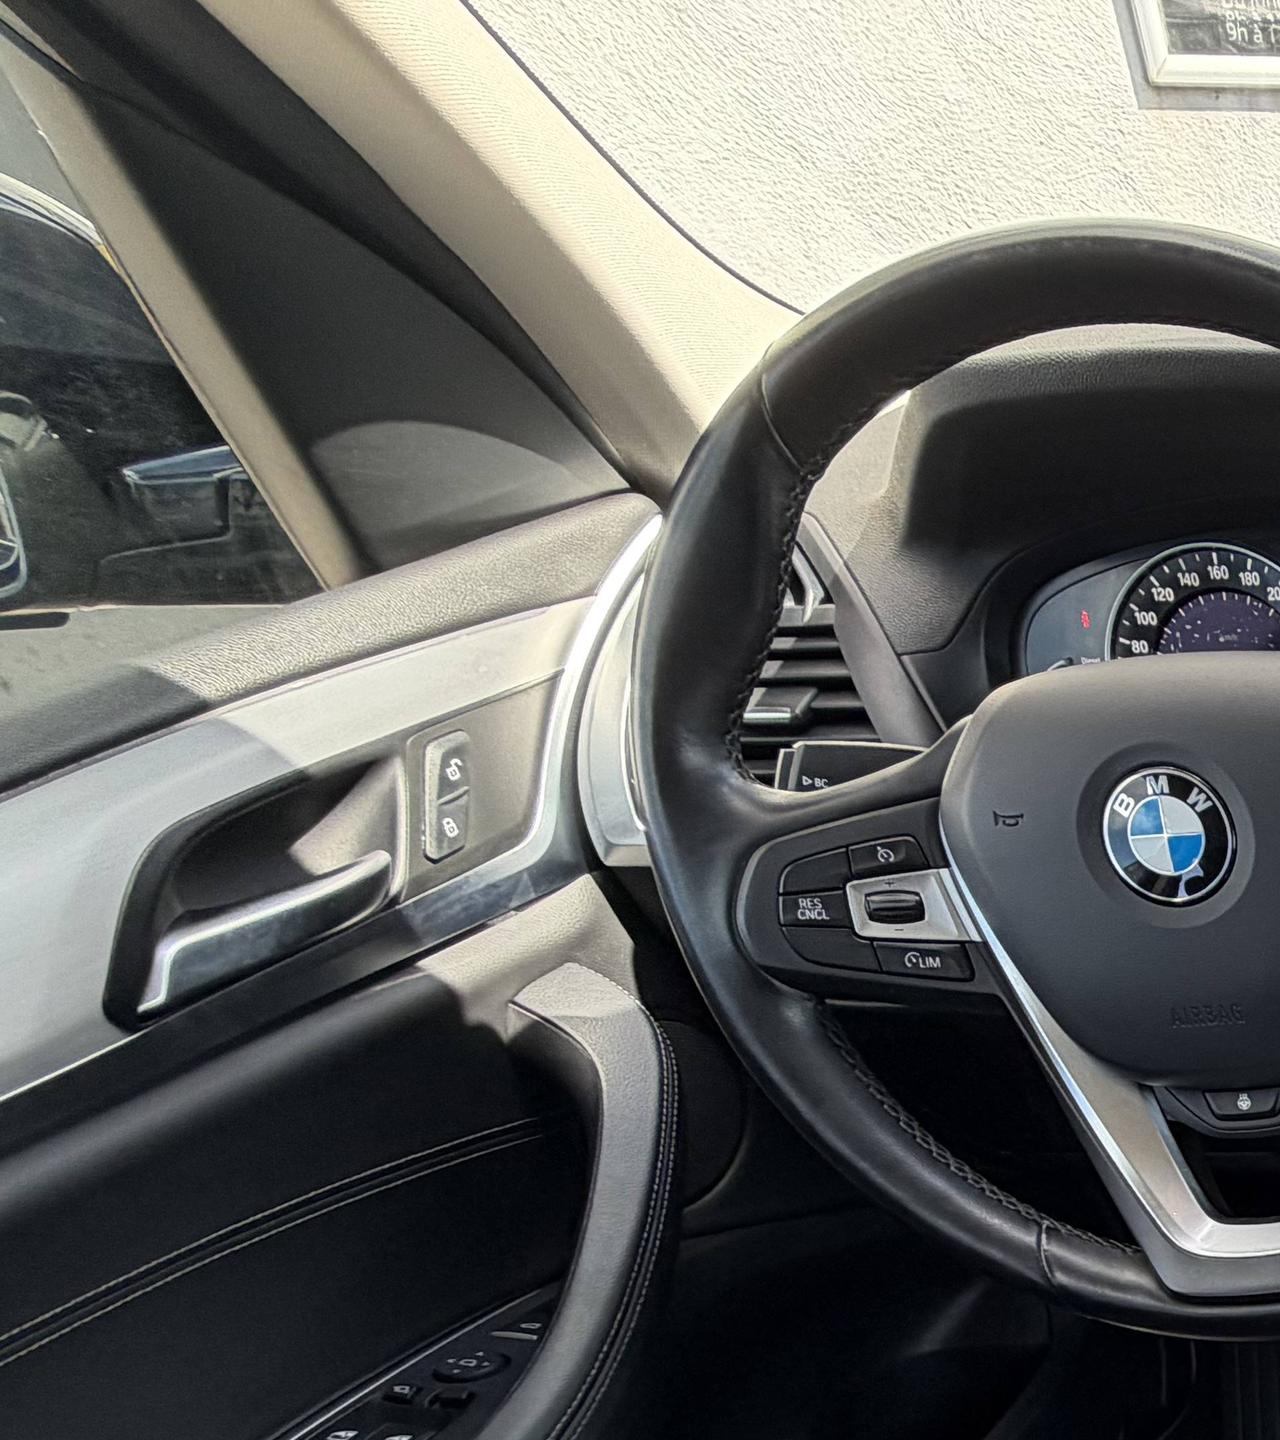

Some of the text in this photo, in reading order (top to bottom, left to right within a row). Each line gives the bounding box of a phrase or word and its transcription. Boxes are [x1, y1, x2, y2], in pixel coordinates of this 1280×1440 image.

[1177, 571, 1200, 587] 140
[1207, 565, 1229, 581] 160
[1239, 571, 1261, 587] 180
[1150, 587, 1175, 602] 120
[1134, 612, 1158, 626] 100
[1131, 640, 1149, 654] 80
[814, 777, 829, 788] BC
[1113, 775, 1213, 818] BMW
[798, 898, 823, 909] RES
[797, 908, 830, 921] CNCL
[918, 956, 941, 969] LIM
